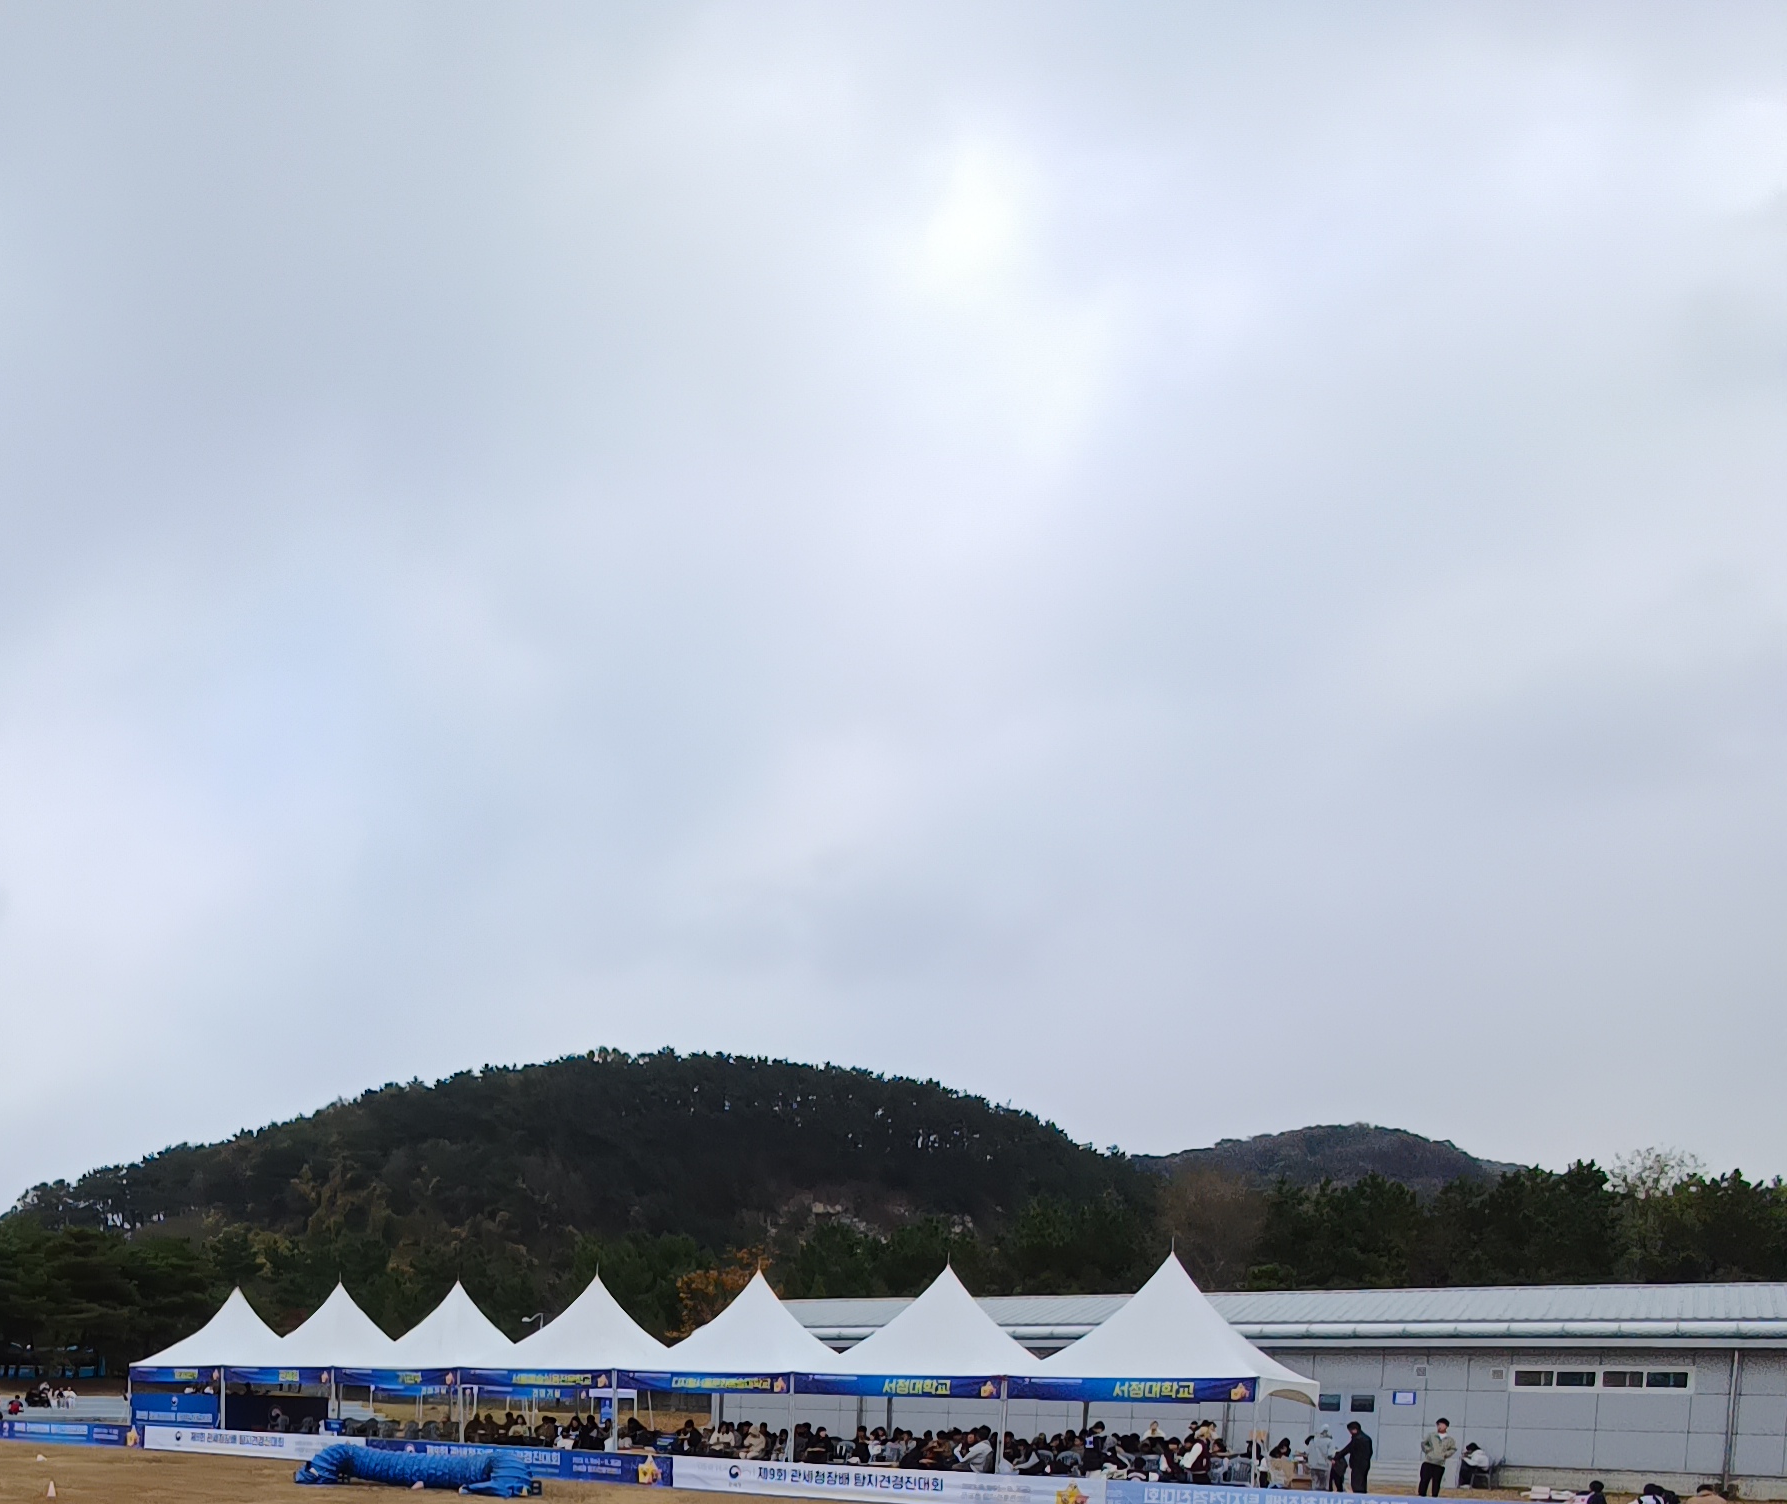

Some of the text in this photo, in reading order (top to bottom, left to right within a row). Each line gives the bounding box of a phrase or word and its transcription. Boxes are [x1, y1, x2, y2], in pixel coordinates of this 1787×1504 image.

[882, 1378, 951, 1395] 서정대학교
[1112, 1379, 1195, 1399] 서정대학교
[757, 1466, 944, 1491] 제9회 관세청장배 탐지견경진대회
